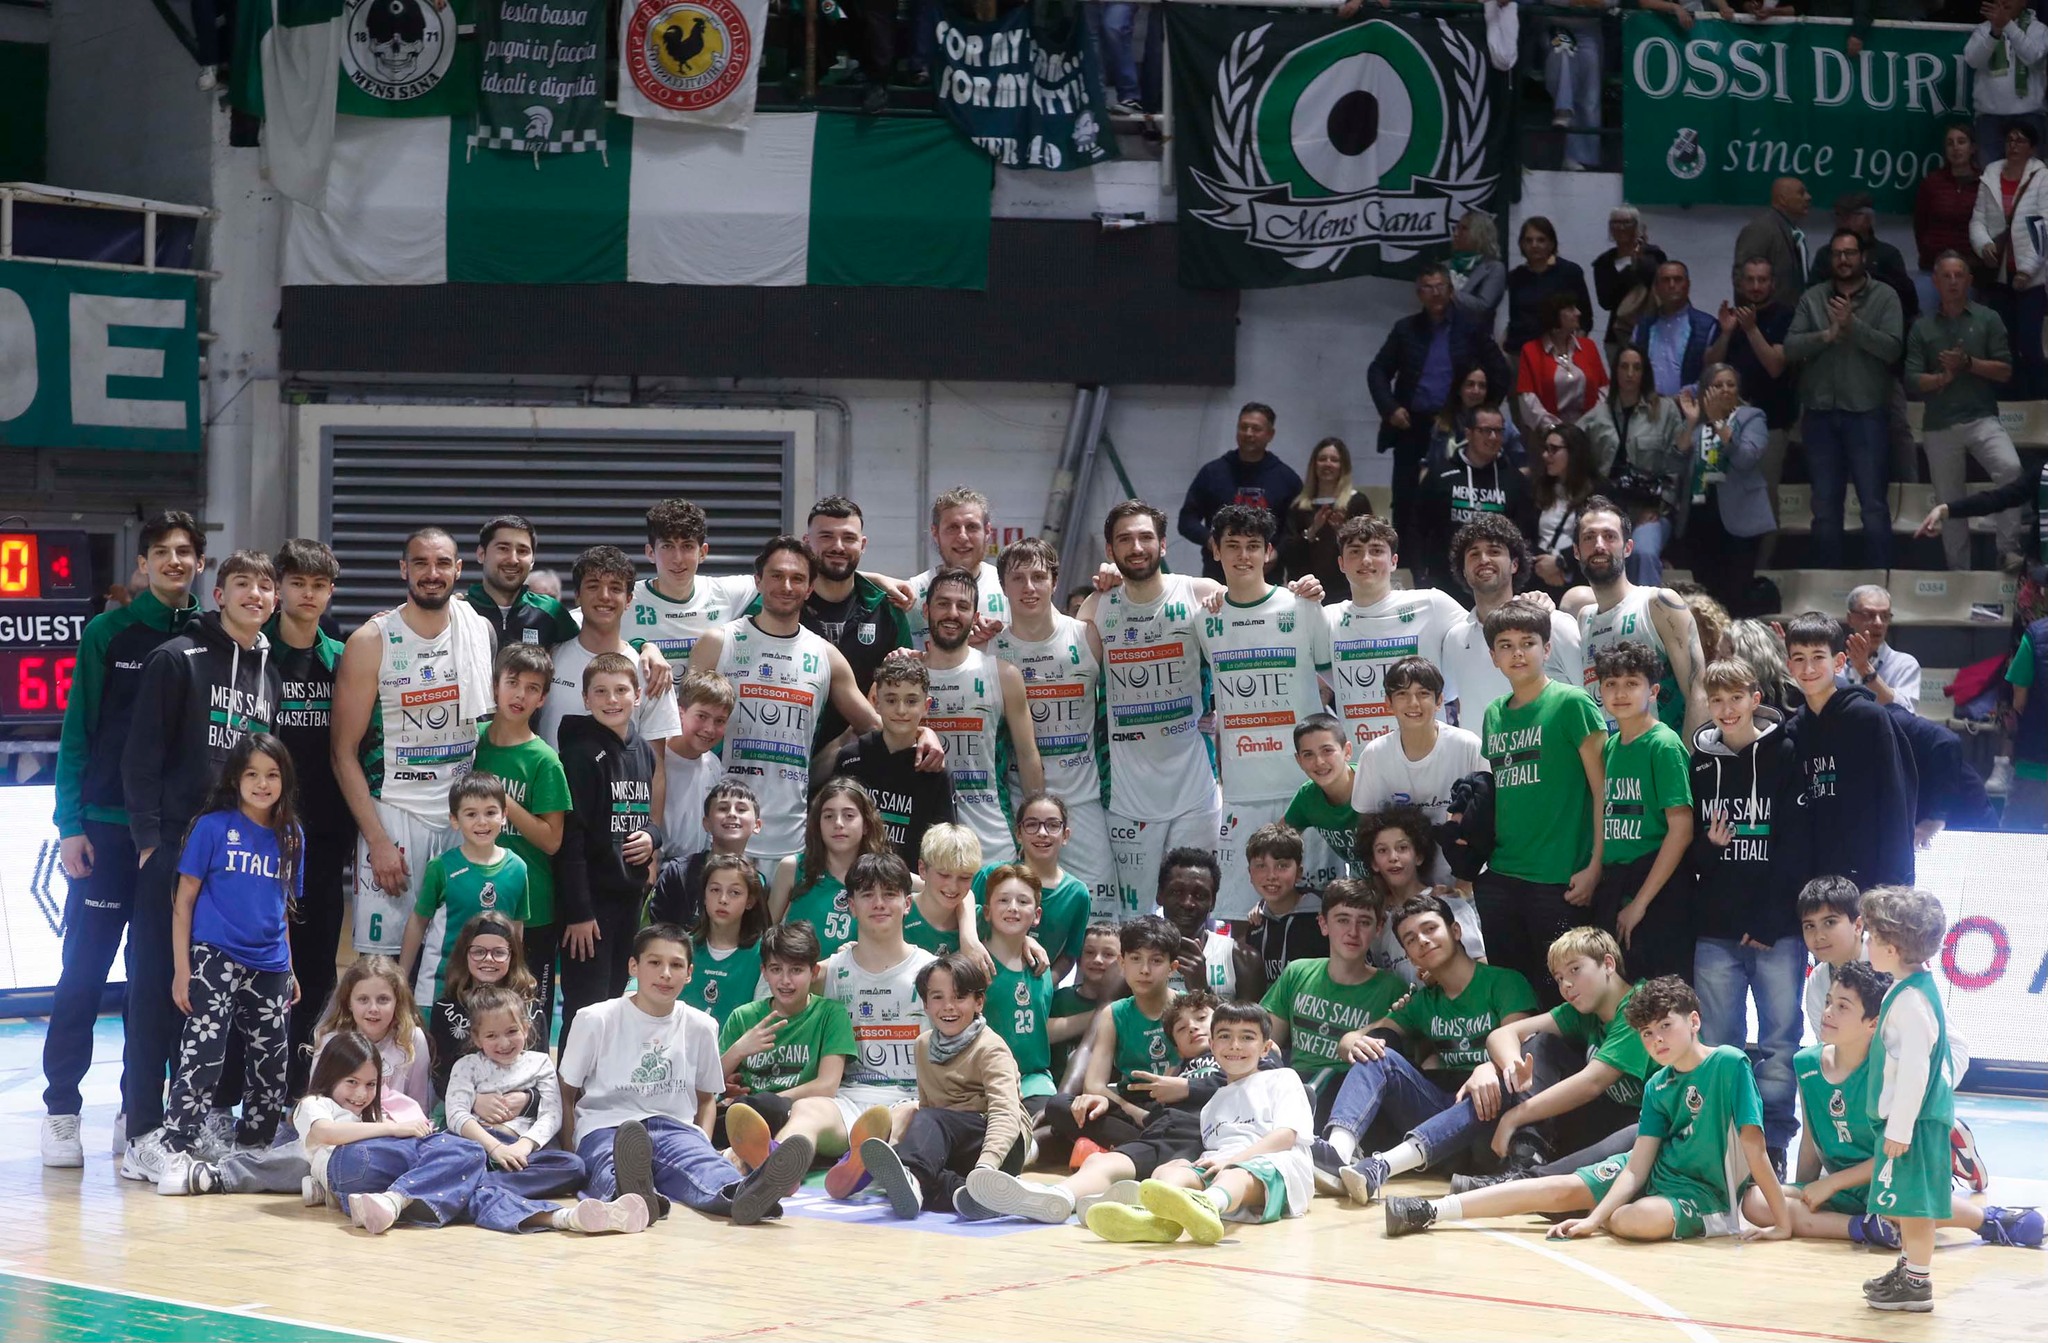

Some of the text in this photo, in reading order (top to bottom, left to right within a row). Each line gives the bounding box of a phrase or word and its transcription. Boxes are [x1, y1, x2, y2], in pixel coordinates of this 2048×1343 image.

[540, 5, 587, 25] bassa
[354, 32, 367, 43] 18
[426, 32, 439, 43] 71
[485, 39, 530, 63] pugni
[532, 39, 548, 60] in
[1632, 37, 1793, 104] OSSI
[351, 71, 440, 99] MENS SANA
[481, 71, 527, 94] ideali
[528, 79, 537, 94] e
[1722, 128, 1833, 177] since
[635, 605, 657, 625] 23
[1164, 602, 1186, 622] 44
[0, 615, 85, 642] GUEST
[1205, 617, 1223, 638] 24
[1621, 613, 1637, 636] 15
[1069, 645, 1079, 664] 3
[1255, 649, 1296, 658] ROTTAMI
[974, 677, 984, 698] 4
[1218, 673, 1288, 699] NOTE
[1236, 735, 1283, 756] famila
[1510, 725, 1542, 748] SANA
[880, 791, 912, 813] SANA
[1604, 818, 1641, 840] ETBALL
[369, 913, 382, 941] 6
[824, 912, 850, 939] 53
[1210, 964, 1224, 986] 12
[1294, 992, 1326, 1024] MENS
[1014, 1009, 1034, 1034] 23
[778, 1045, 810, 1064] SANA
[1878, 1158, 1893, 1189] 4
